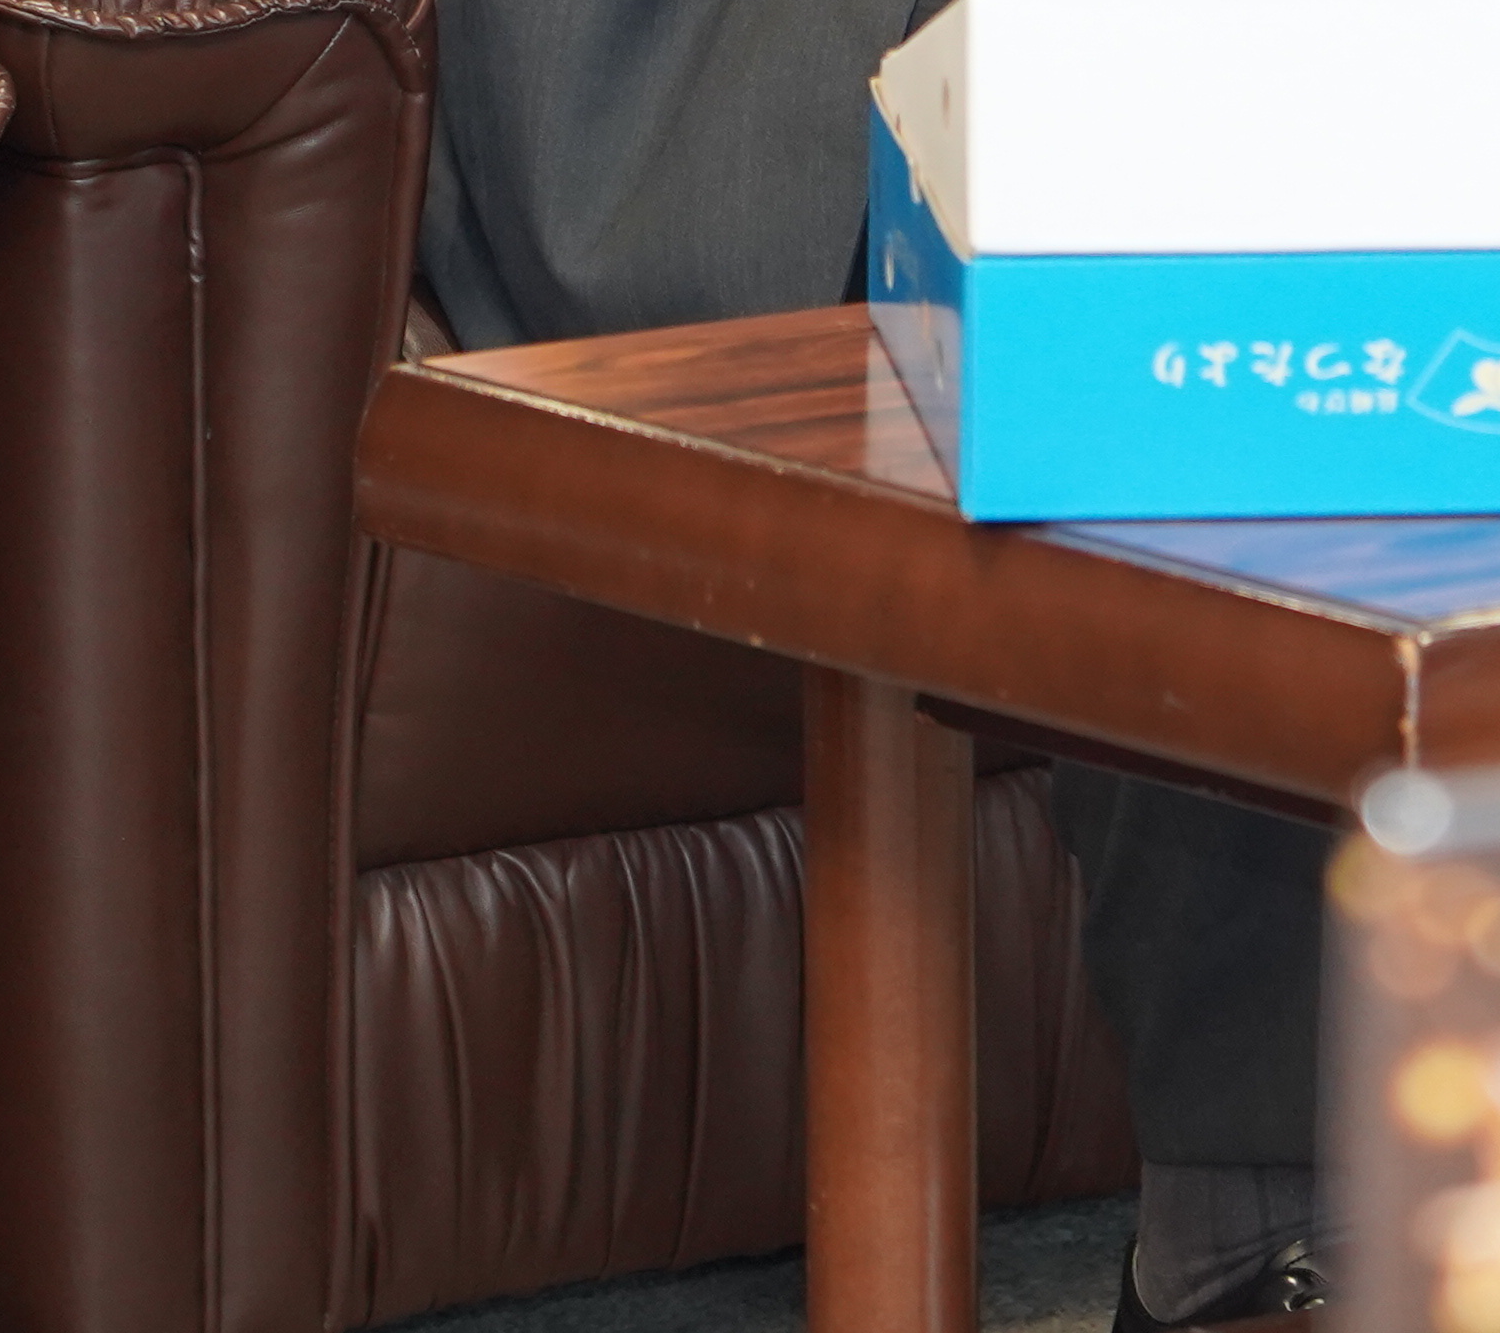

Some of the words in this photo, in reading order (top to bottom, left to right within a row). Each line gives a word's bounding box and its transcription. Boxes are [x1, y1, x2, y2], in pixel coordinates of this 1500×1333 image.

[1152, 338, 1406, 387] なつたより
